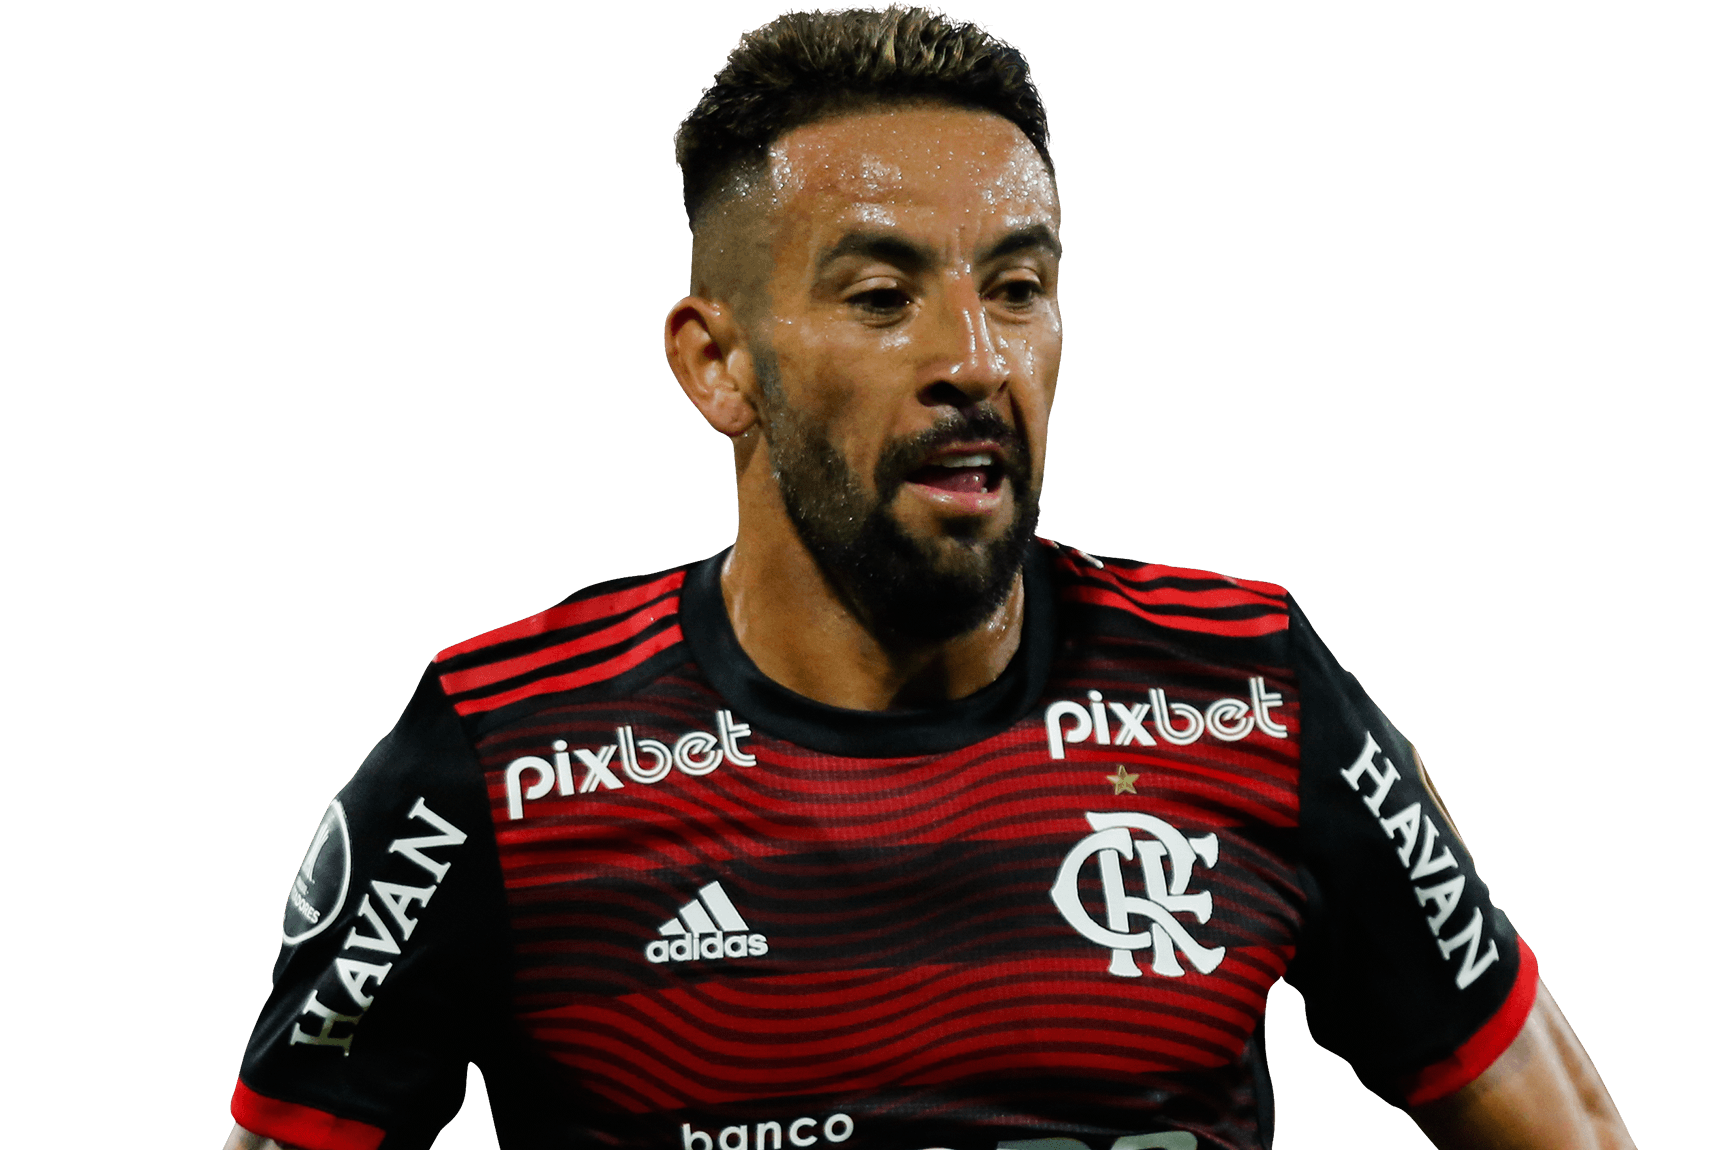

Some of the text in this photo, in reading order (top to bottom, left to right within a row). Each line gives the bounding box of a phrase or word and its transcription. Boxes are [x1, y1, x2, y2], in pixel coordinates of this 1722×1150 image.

[504, 709, 757, 820] pixbet
[1044, 676, 1288, 760] pixbet
[1340, 730, 1500, 990] HAVAN
[288, 796, 468, 1057] HAVAN
[646, 929, 769, 964] adidas
